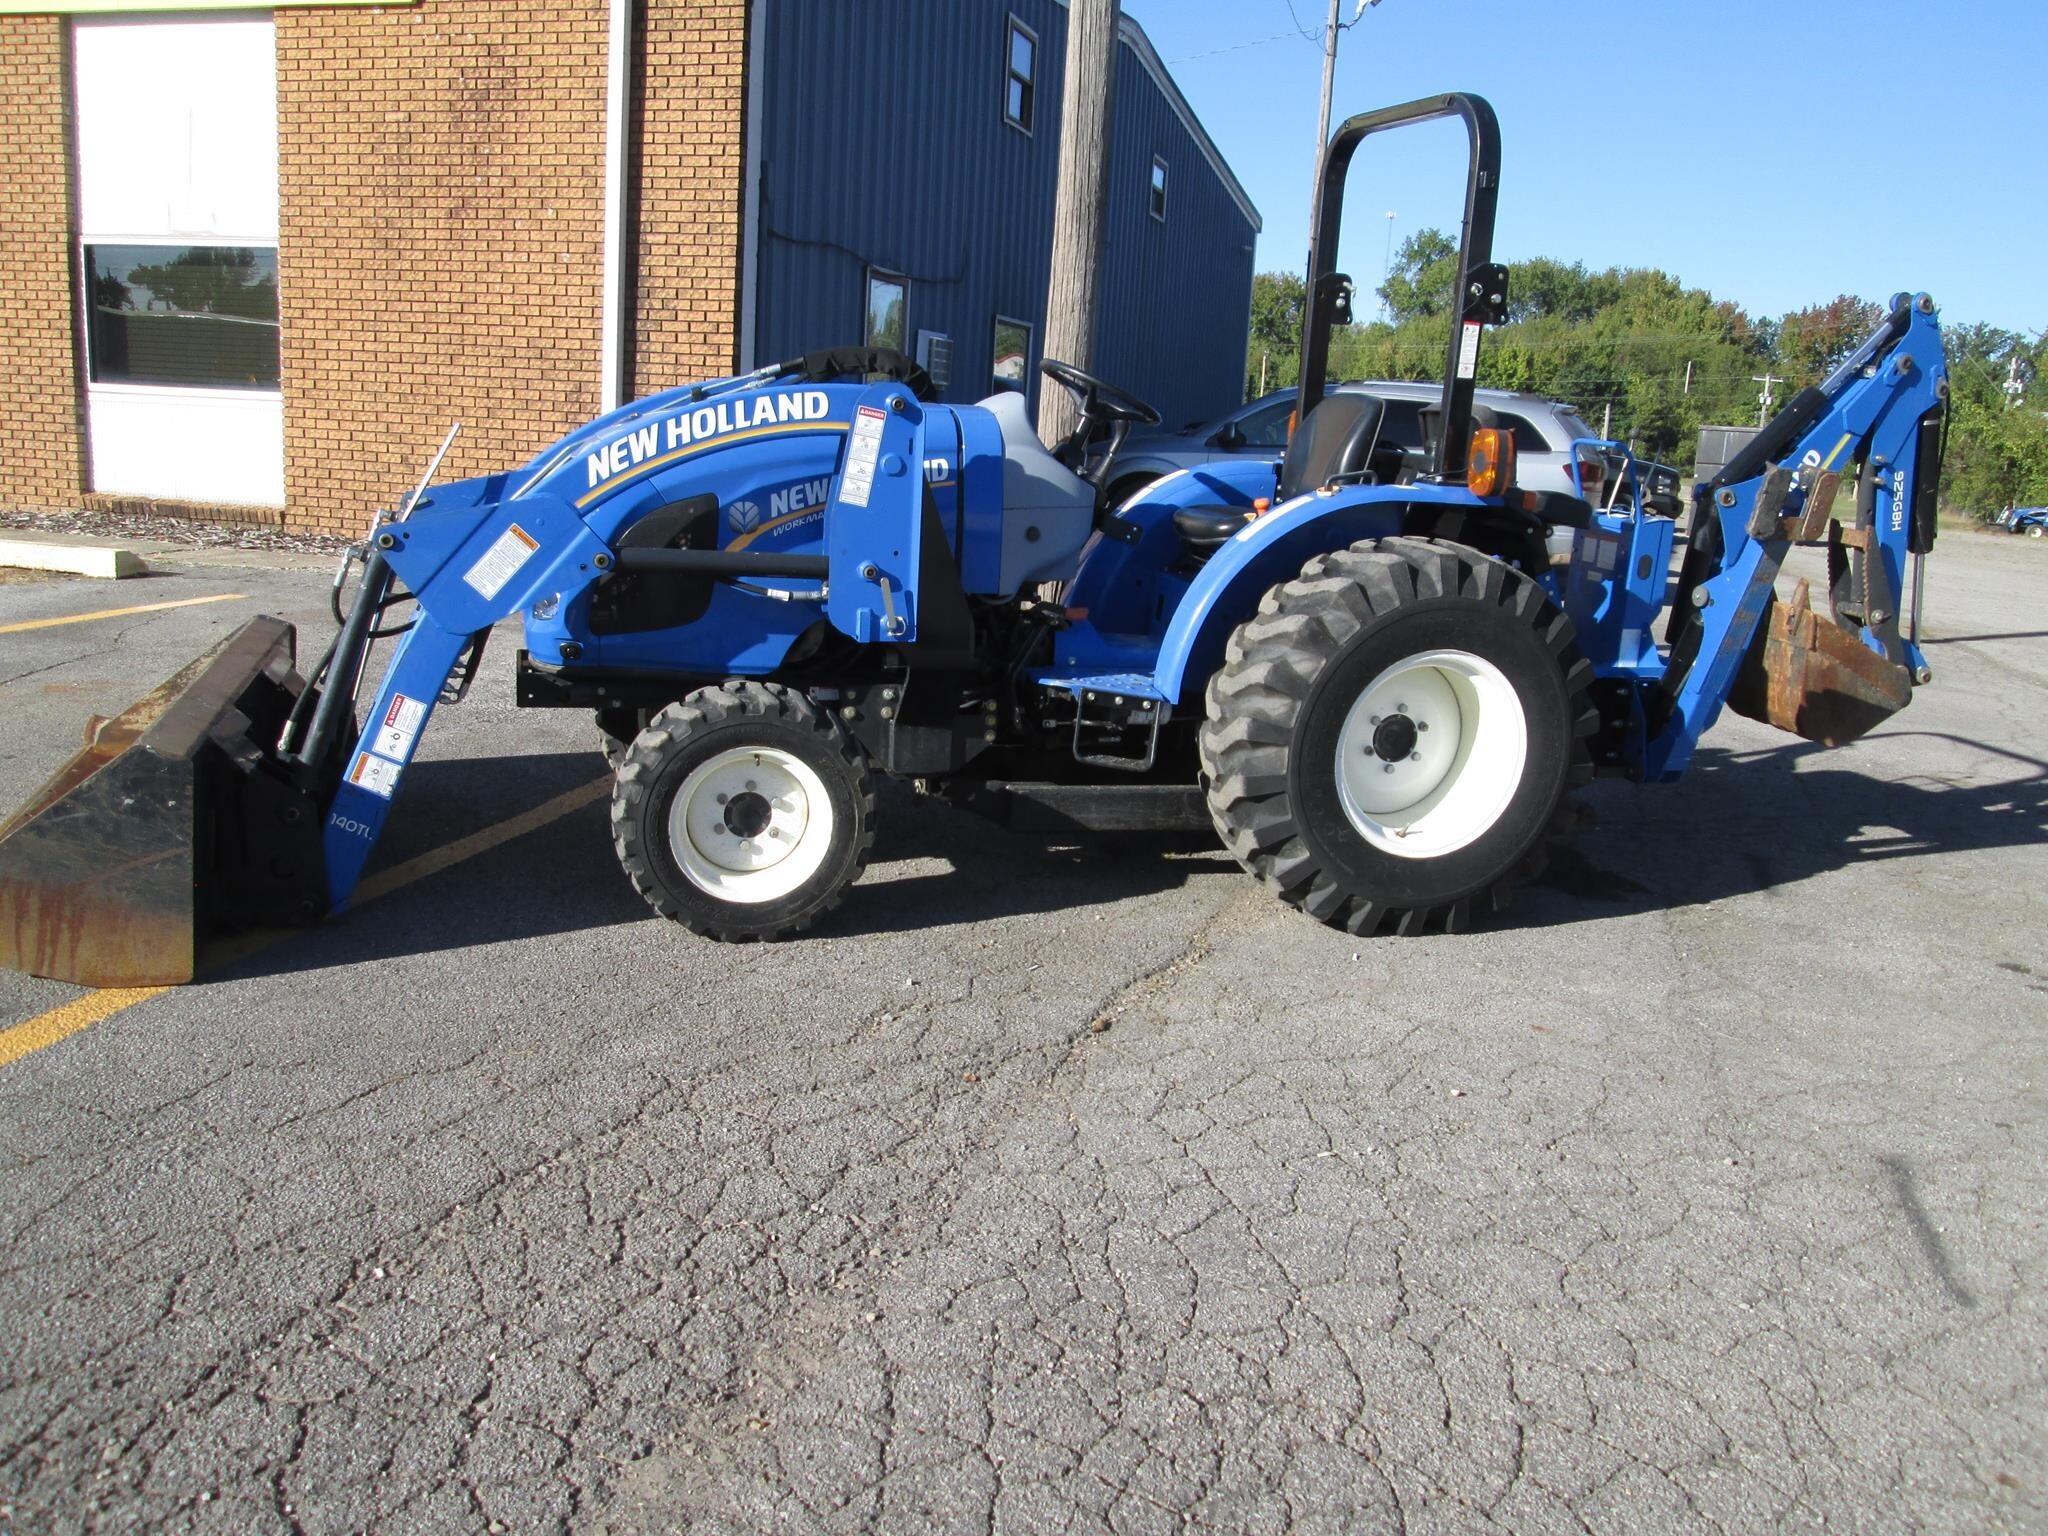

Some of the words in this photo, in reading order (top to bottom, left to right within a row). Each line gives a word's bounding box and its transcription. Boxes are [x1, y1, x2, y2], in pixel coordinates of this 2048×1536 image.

[588, 423, 659, 488] NEW
[667, 391, 829, 450] HOLLAND
[770, 478, 829, 518] NEW
[1891, 471, 1904, 531] 925GBH
[391, 697, 403, 720] DANGER
